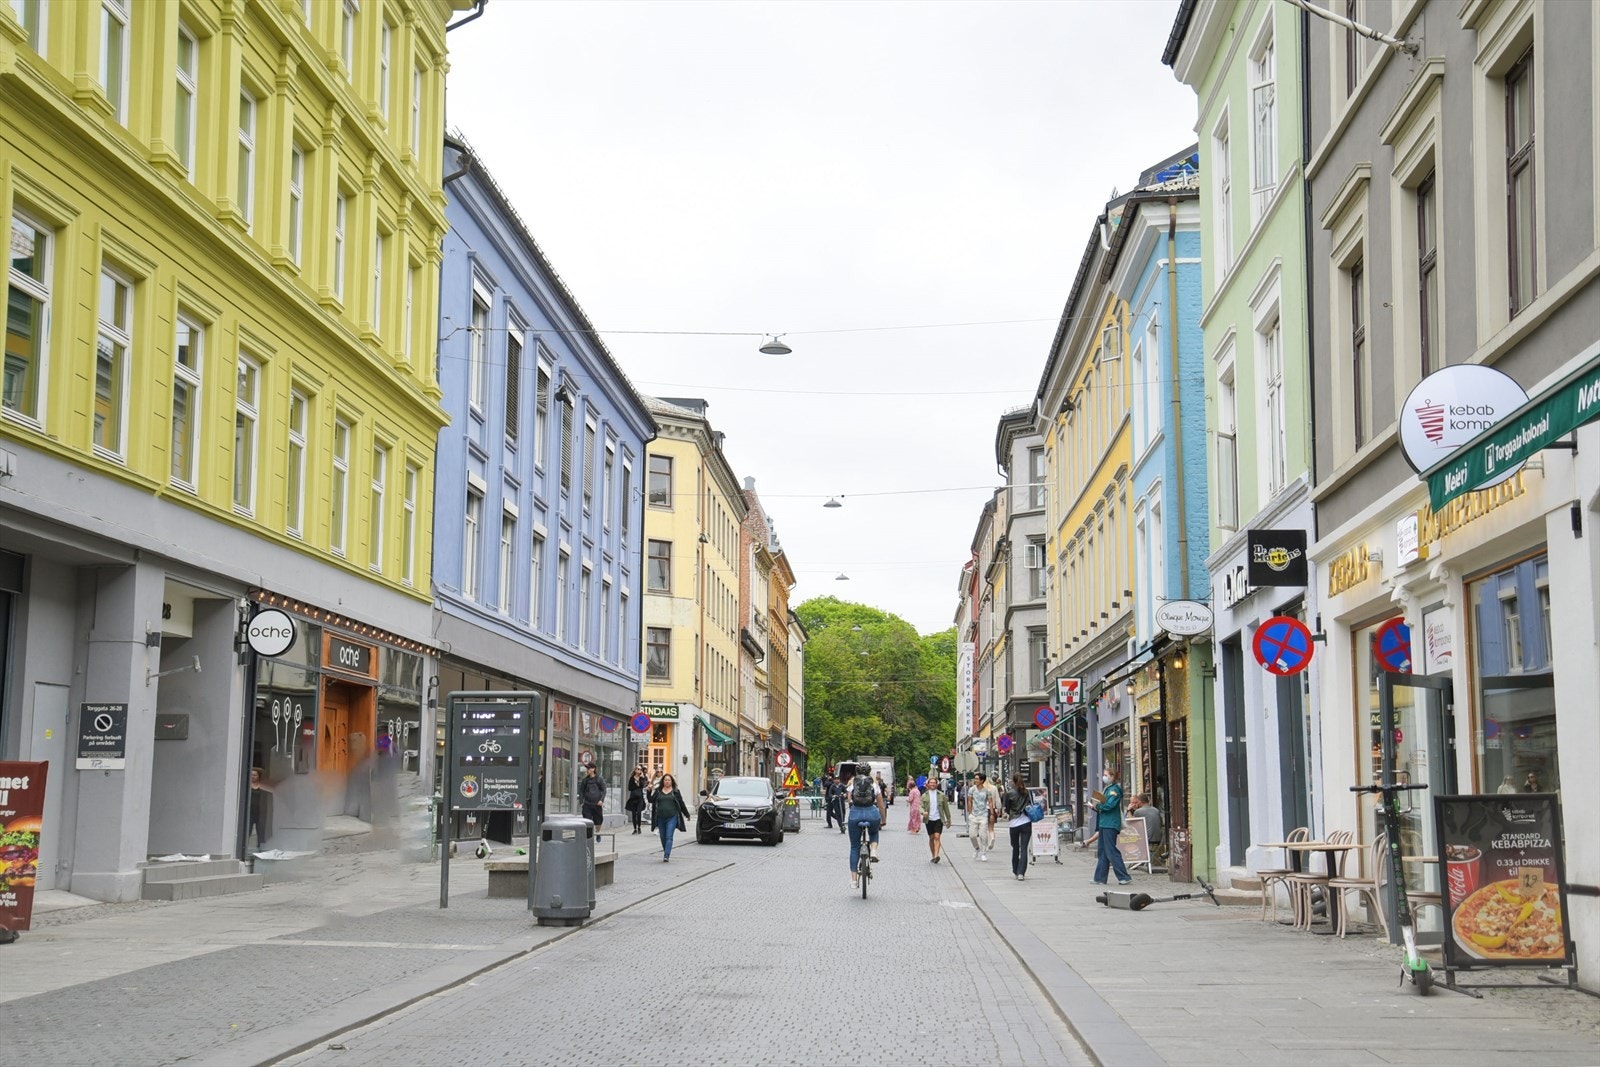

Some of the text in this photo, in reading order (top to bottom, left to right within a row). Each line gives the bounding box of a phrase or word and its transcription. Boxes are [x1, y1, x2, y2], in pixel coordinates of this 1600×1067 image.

[1450, 405, 1494, 416] kebab
[1495, 412, 1549, 461] Torggata kolonial
[1444, 462, 1468, 495] Meieri
[1253, 548, 1302, 563] Martens
[1328, 541, 1370, 598] KEBAB
[250, 626, 291, 638] oche
[340, 646, 359, 667] oche
[1491, 839, 1552, 849] KEBABPIZZA
